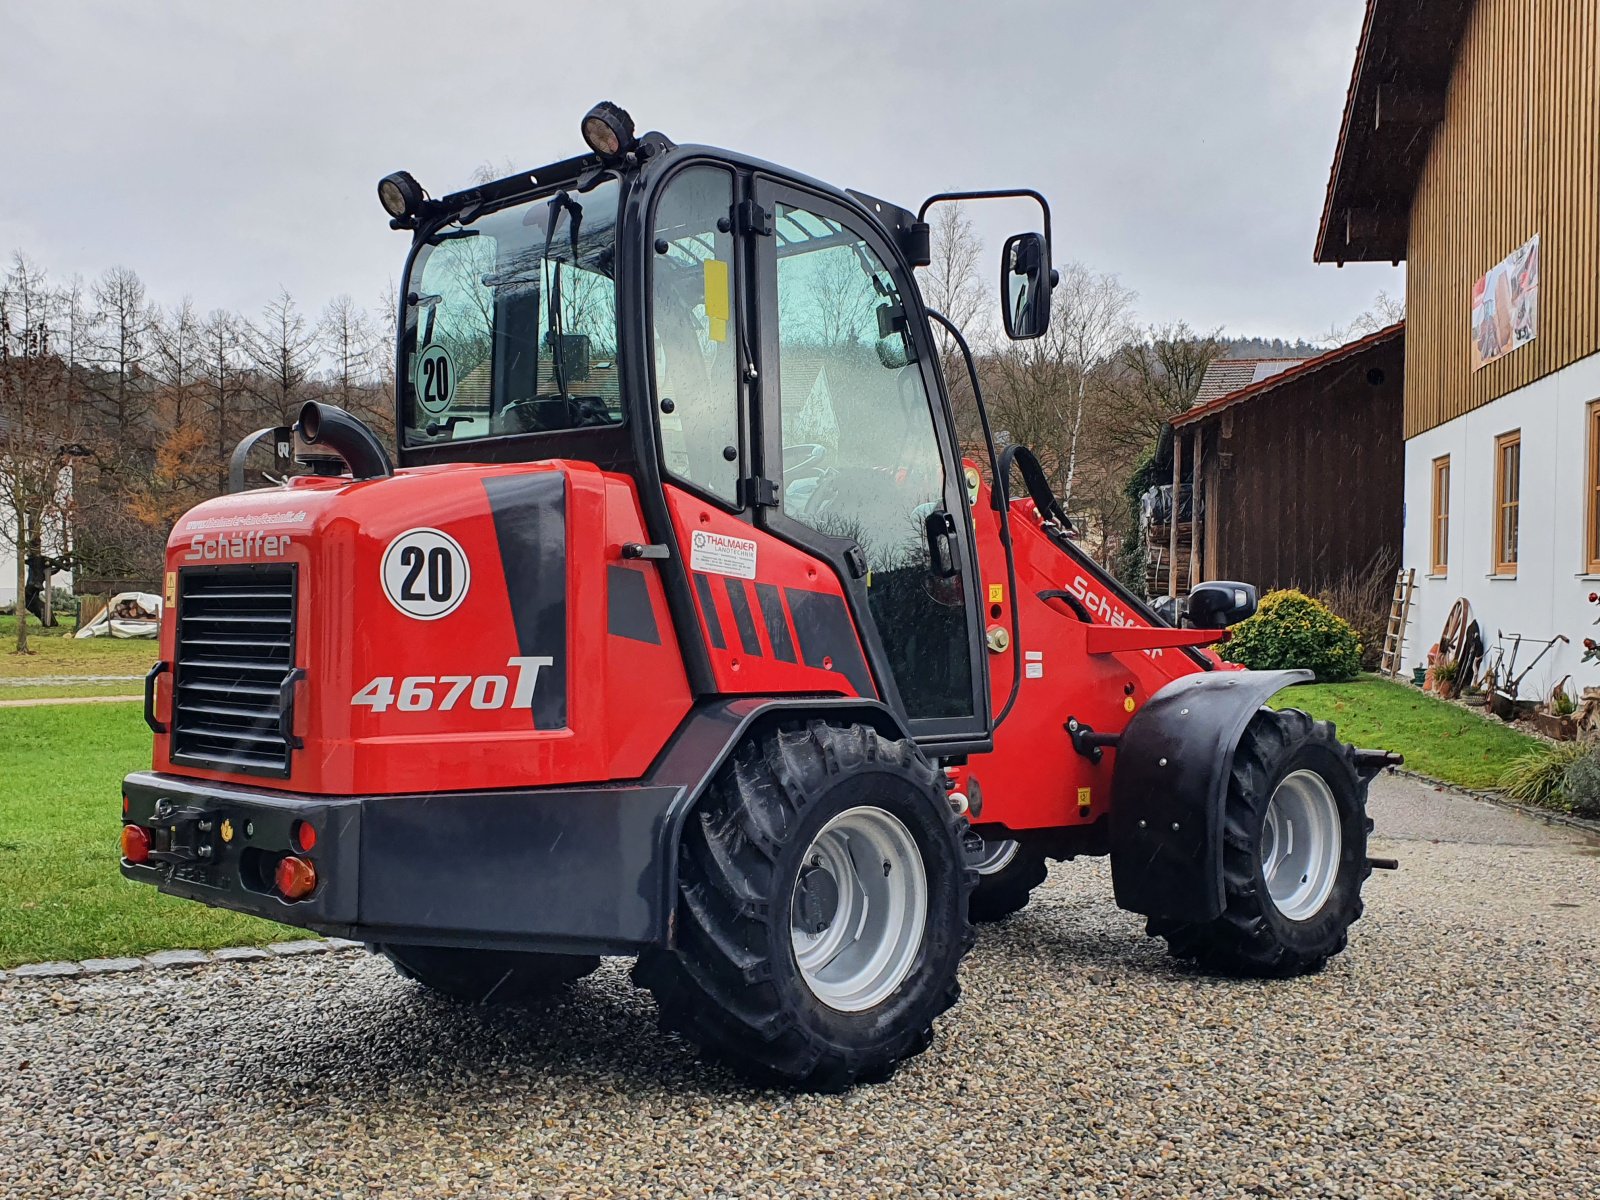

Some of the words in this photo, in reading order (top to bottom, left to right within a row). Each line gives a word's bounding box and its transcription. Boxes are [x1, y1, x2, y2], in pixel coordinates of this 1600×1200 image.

[423, 356, 449, 402] 20
[185, 530, 291, 560] Schäffer
[706, 535, 754, 552] THALMAIER
[714, 546, 754, 558] LANDTECHNIK
[400, 546, 453, 602] 20
